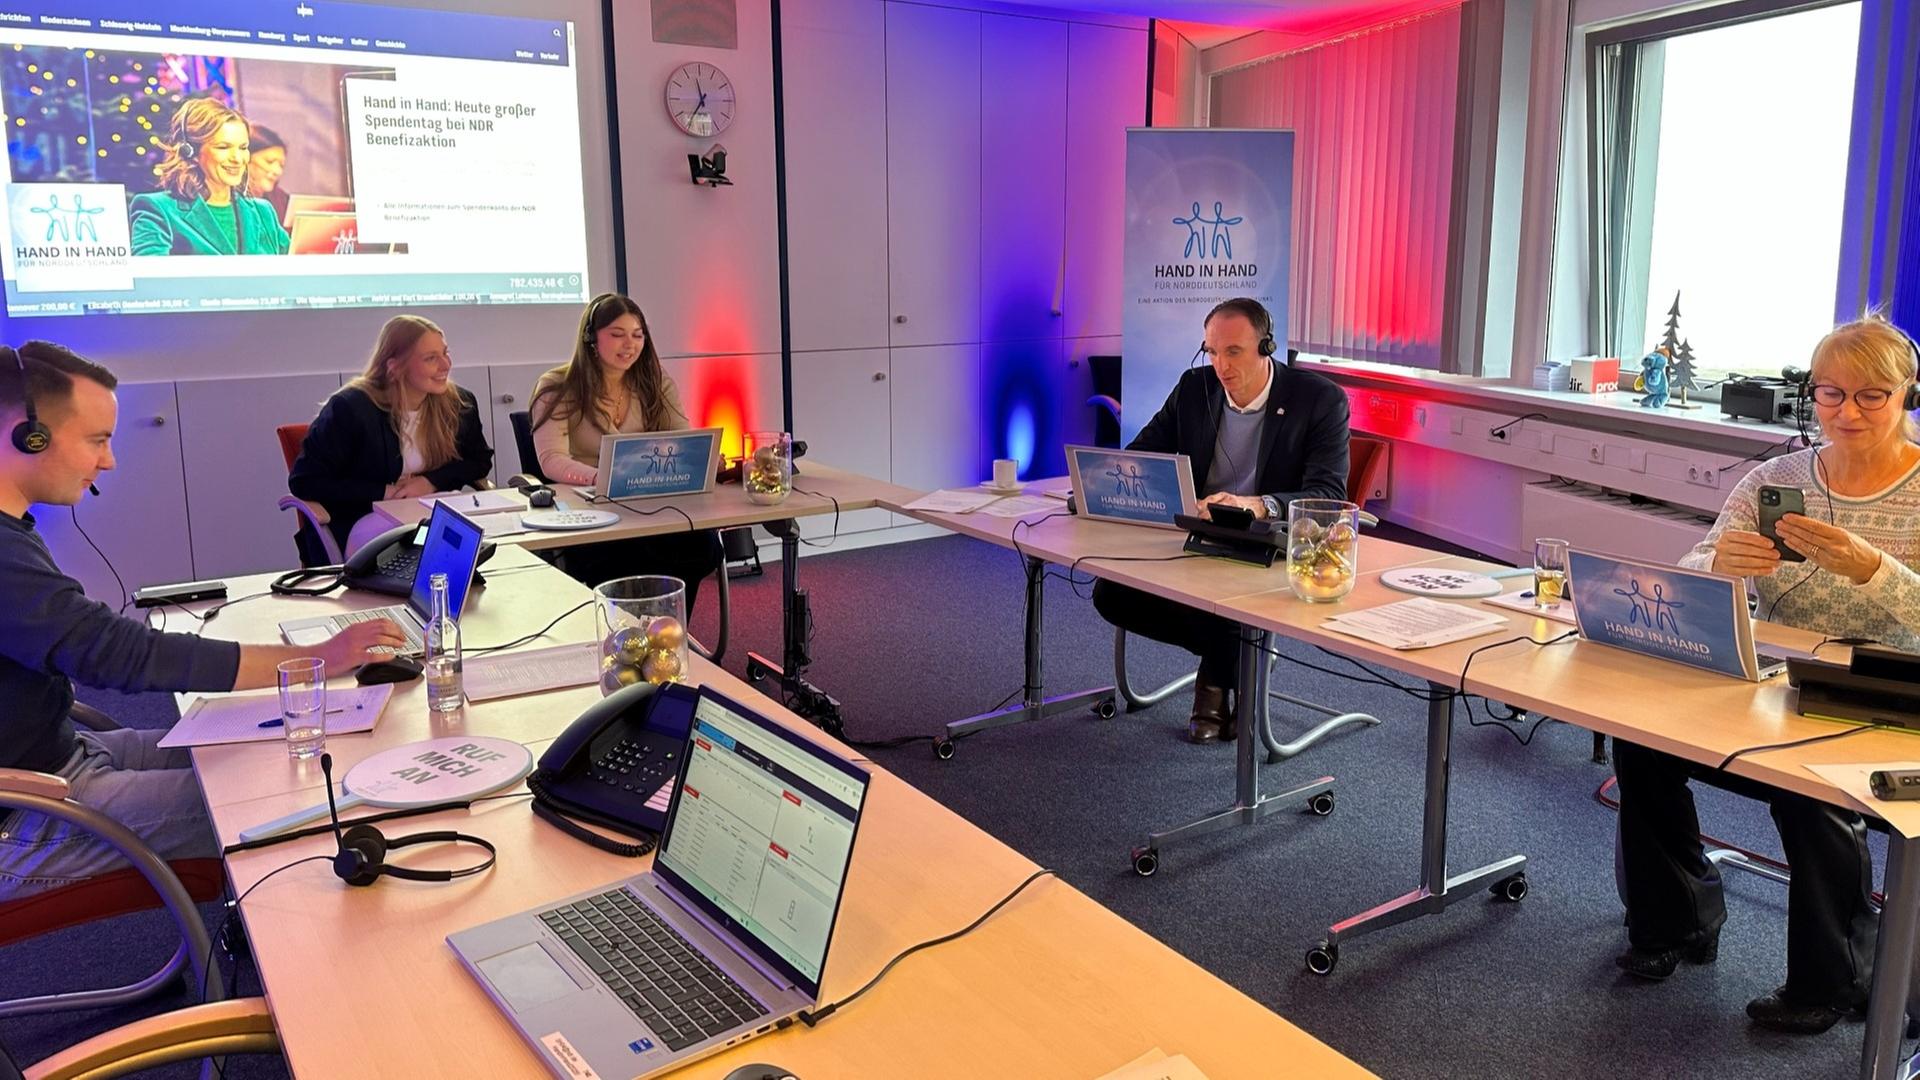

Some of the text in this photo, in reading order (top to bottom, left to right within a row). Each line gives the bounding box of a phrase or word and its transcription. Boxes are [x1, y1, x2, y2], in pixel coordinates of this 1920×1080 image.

[363, 95, 537, 119] Hand in Hand: Heute großer
[365, 114, 494, 133] Spendentag bei NDR
[366, 132, 456, 148] Benefizaktion
[16, 245, 127, 259] HAND IN HAND
[1154, 264, 1258, 278] HAND IN HAND
[1154, 280, 1257, 290] FÜR NORDDEUTSCHLAND
[626, 477, 652, 486] HAND
[655, 475, 663, 483] IN
[665, 473, 691, 483] HAND
[1100, 495, 1126, 506] HAND
[1128, 499, 1138, 508] IN
[1140, 500, 1167, 510] HAND
[1603, 621, 1711, 655] HAND IN HAND
[451, 743, 507, 763] RUF
[413, 751, 482, 778] MICH
[391, 766, 440, 785] AN
